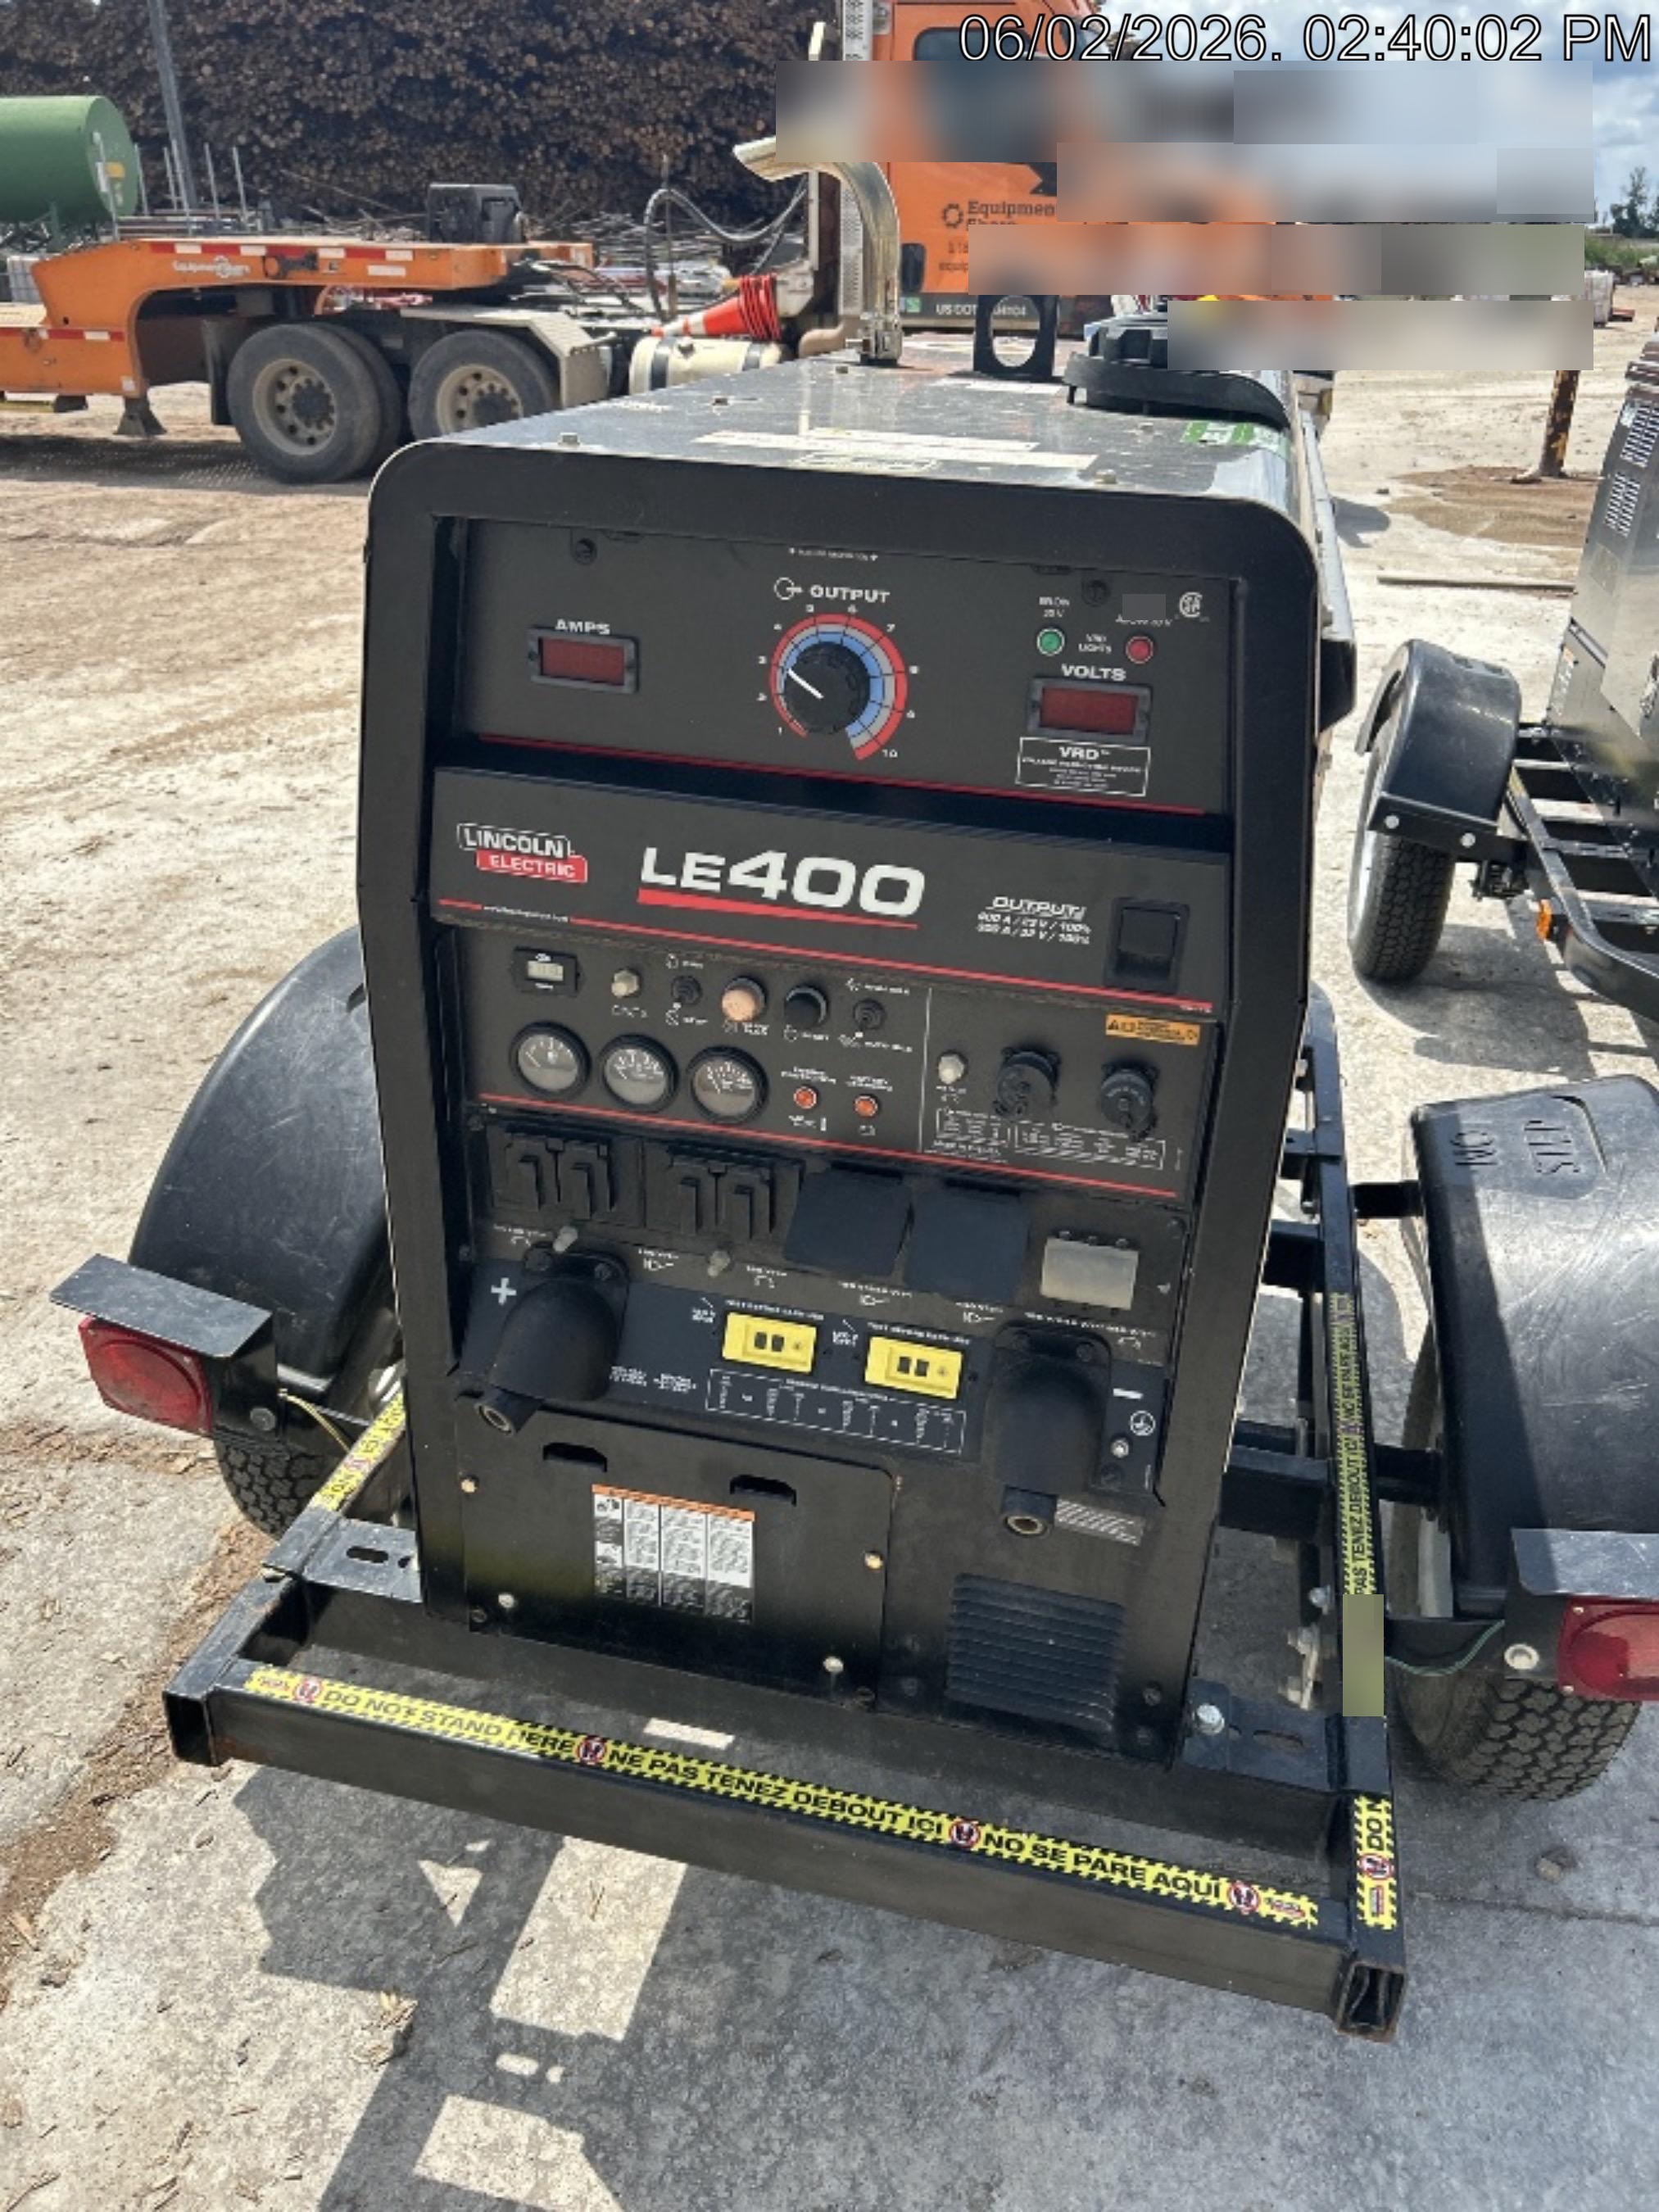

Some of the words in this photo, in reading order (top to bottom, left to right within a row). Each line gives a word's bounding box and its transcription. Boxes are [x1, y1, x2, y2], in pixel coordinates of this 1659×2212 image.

[968, 201, 1057, 218] Equipmen
[809, 584, 891, 603] OUTPUT
[555, 619, 611, 635] AMPS
[1061, 663, 1127, 682] VOLTS
[462, 827, 564, 859] LINCOLN
[489, 854, 576, 878] ELECTRIC
[640, 845, 926, 918] LE400
[324, 1690, 360, 1707] DO
[365, 1697, 415, 1720] NOT
[420, 1711, 503, 1738] STAND
[507, 1729, 574, 1752] HERE
[608, 1751, 642, 1770] NE
[648, 1758, 700, 1781] PAS
[705, 1770, 787, 1800] TENEZ
[793, 1789, 902, 1825] DEBOUT
[908, 1815, 944, 1836] ICI
[982, 1832, 1024, 1854] NO
[1031, 1843, 1069, 1864] SE
[1072, 1852, 1147, 1883] PARE
[1366, 1817, 1385, 1851] DO
